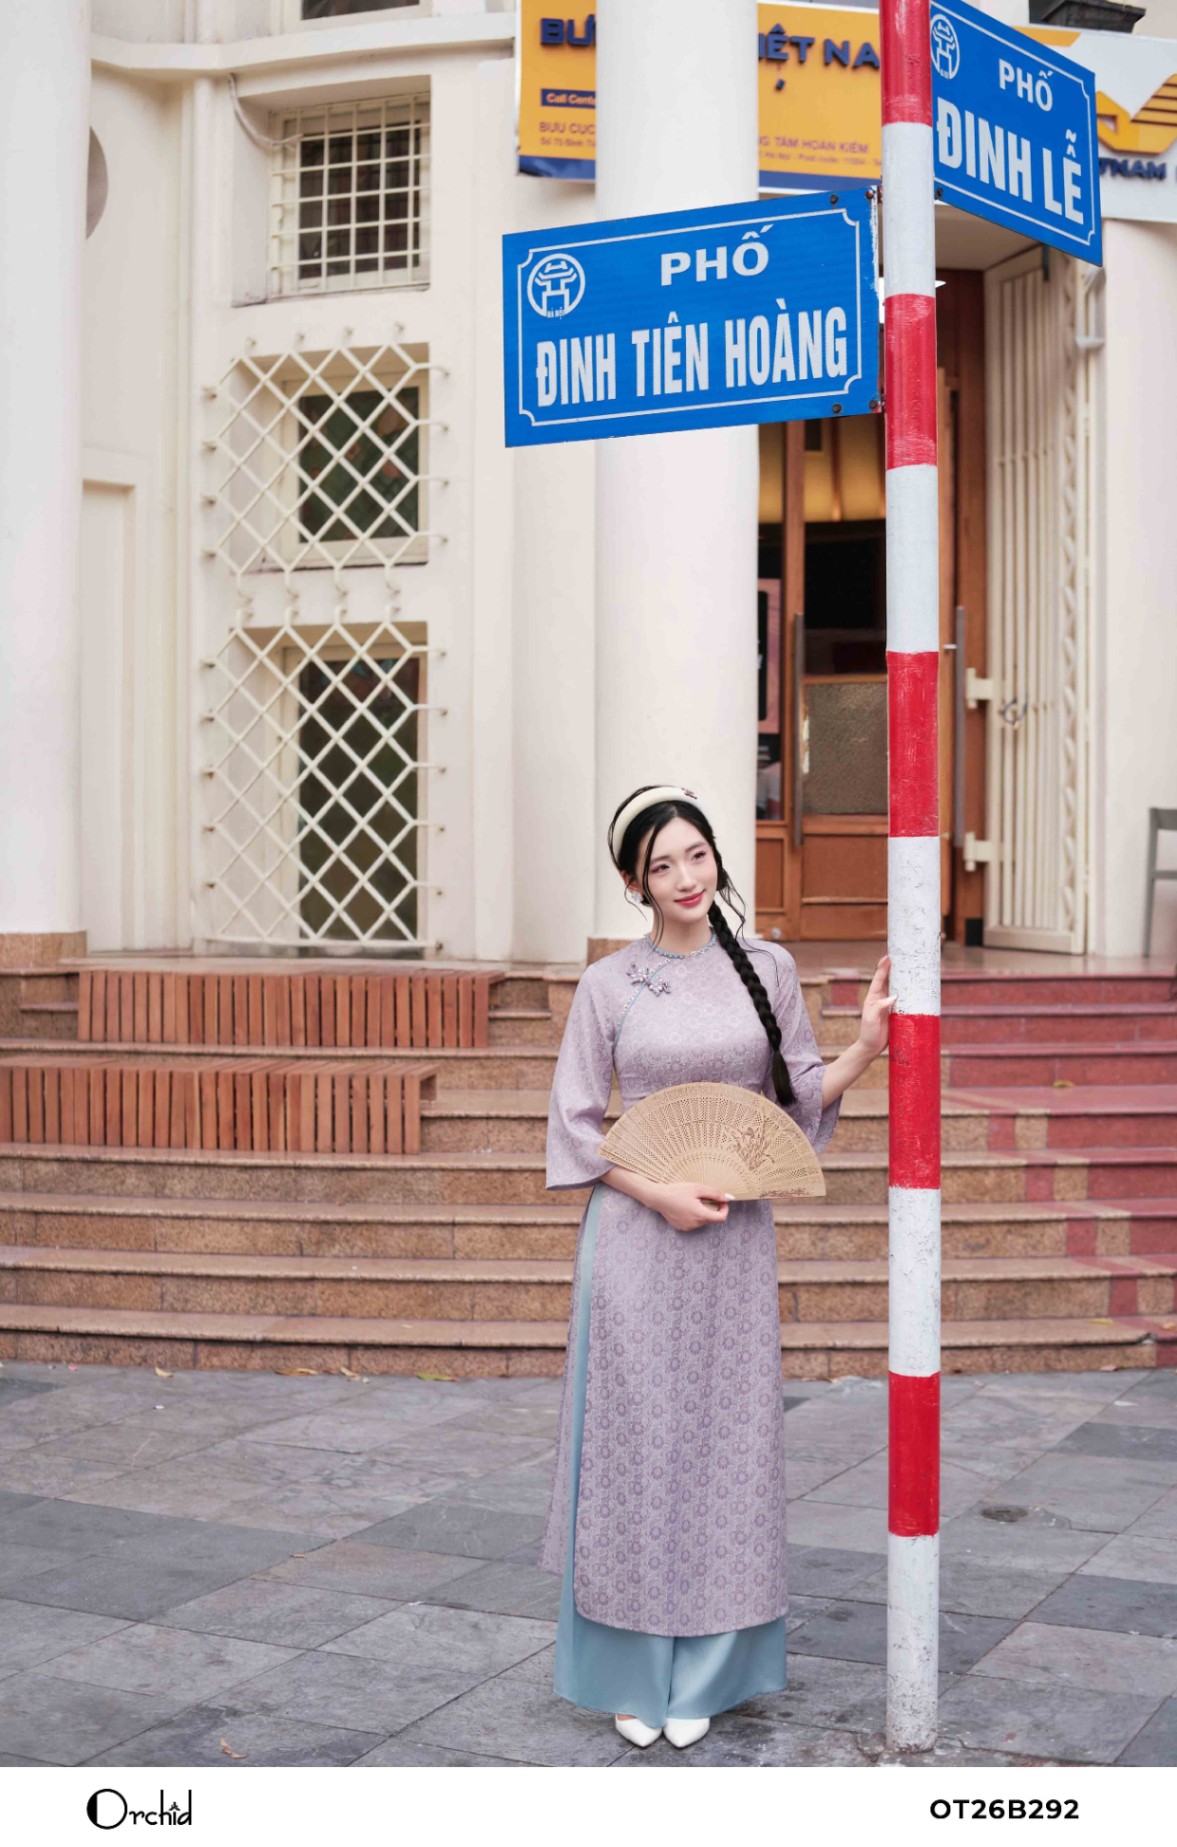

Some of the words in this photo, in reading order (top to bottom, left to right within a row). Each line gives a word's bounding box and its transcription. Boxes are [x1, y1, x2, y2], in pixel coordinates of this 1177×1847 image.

[540, 14, 595, 46] BƯ
[758, 24, 815, 90] IỆT
[823, 39, 880, 69] NA
[999, 58, 1053, 112] PHỐ
[937, 97, 1033, 203] ĐINH
[1042, 129, 1084, 225] LỄ
[661, 224, 774, 286] PHỐ
[536, 333, 616, 407] ĐINH
[631, 311, 709, 397] TIÊN
[725, 298, 847, 388] HOÀNG
